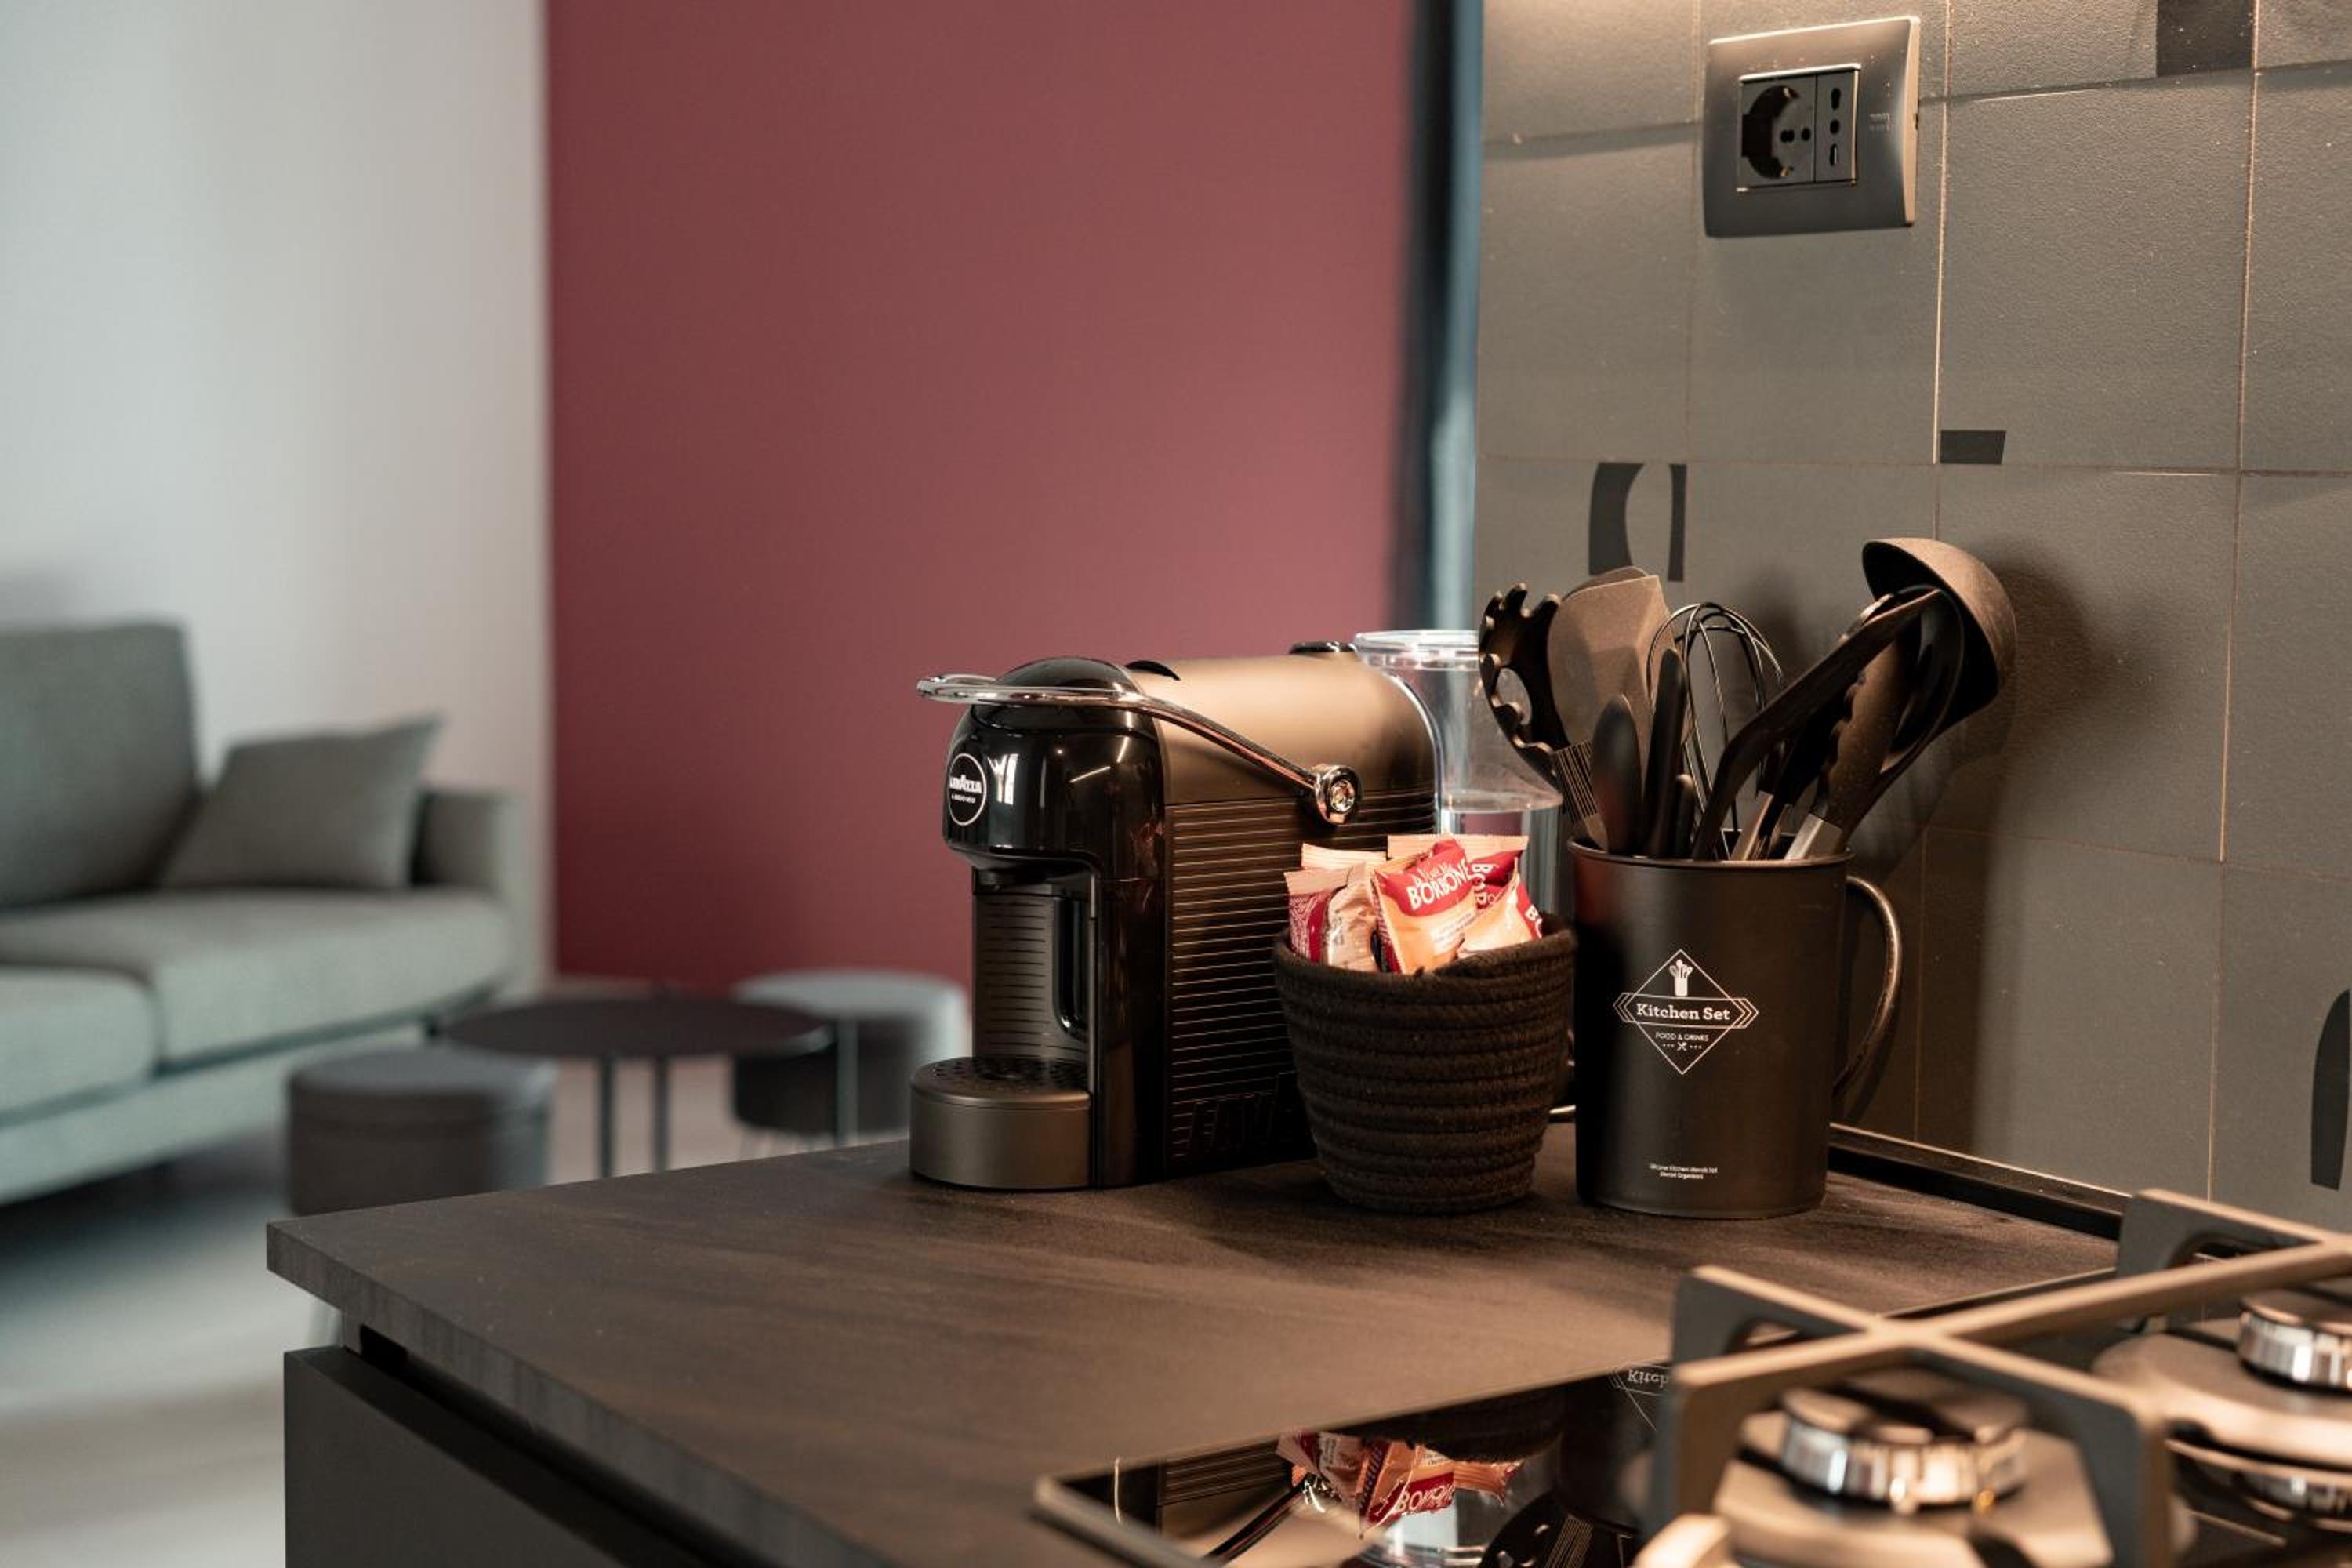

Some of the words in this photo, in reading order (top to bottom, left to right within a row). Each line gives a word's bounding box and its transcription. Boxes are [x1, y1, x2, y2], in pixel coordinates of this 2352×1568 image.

[1406, 858, 1470, 911] BORBONE
[1636, 1003, 1700, 1020] Kitchen
[1703, 1007, 1731, 1021] Set
[1655, 1032, 1677, 1040] FOOD
